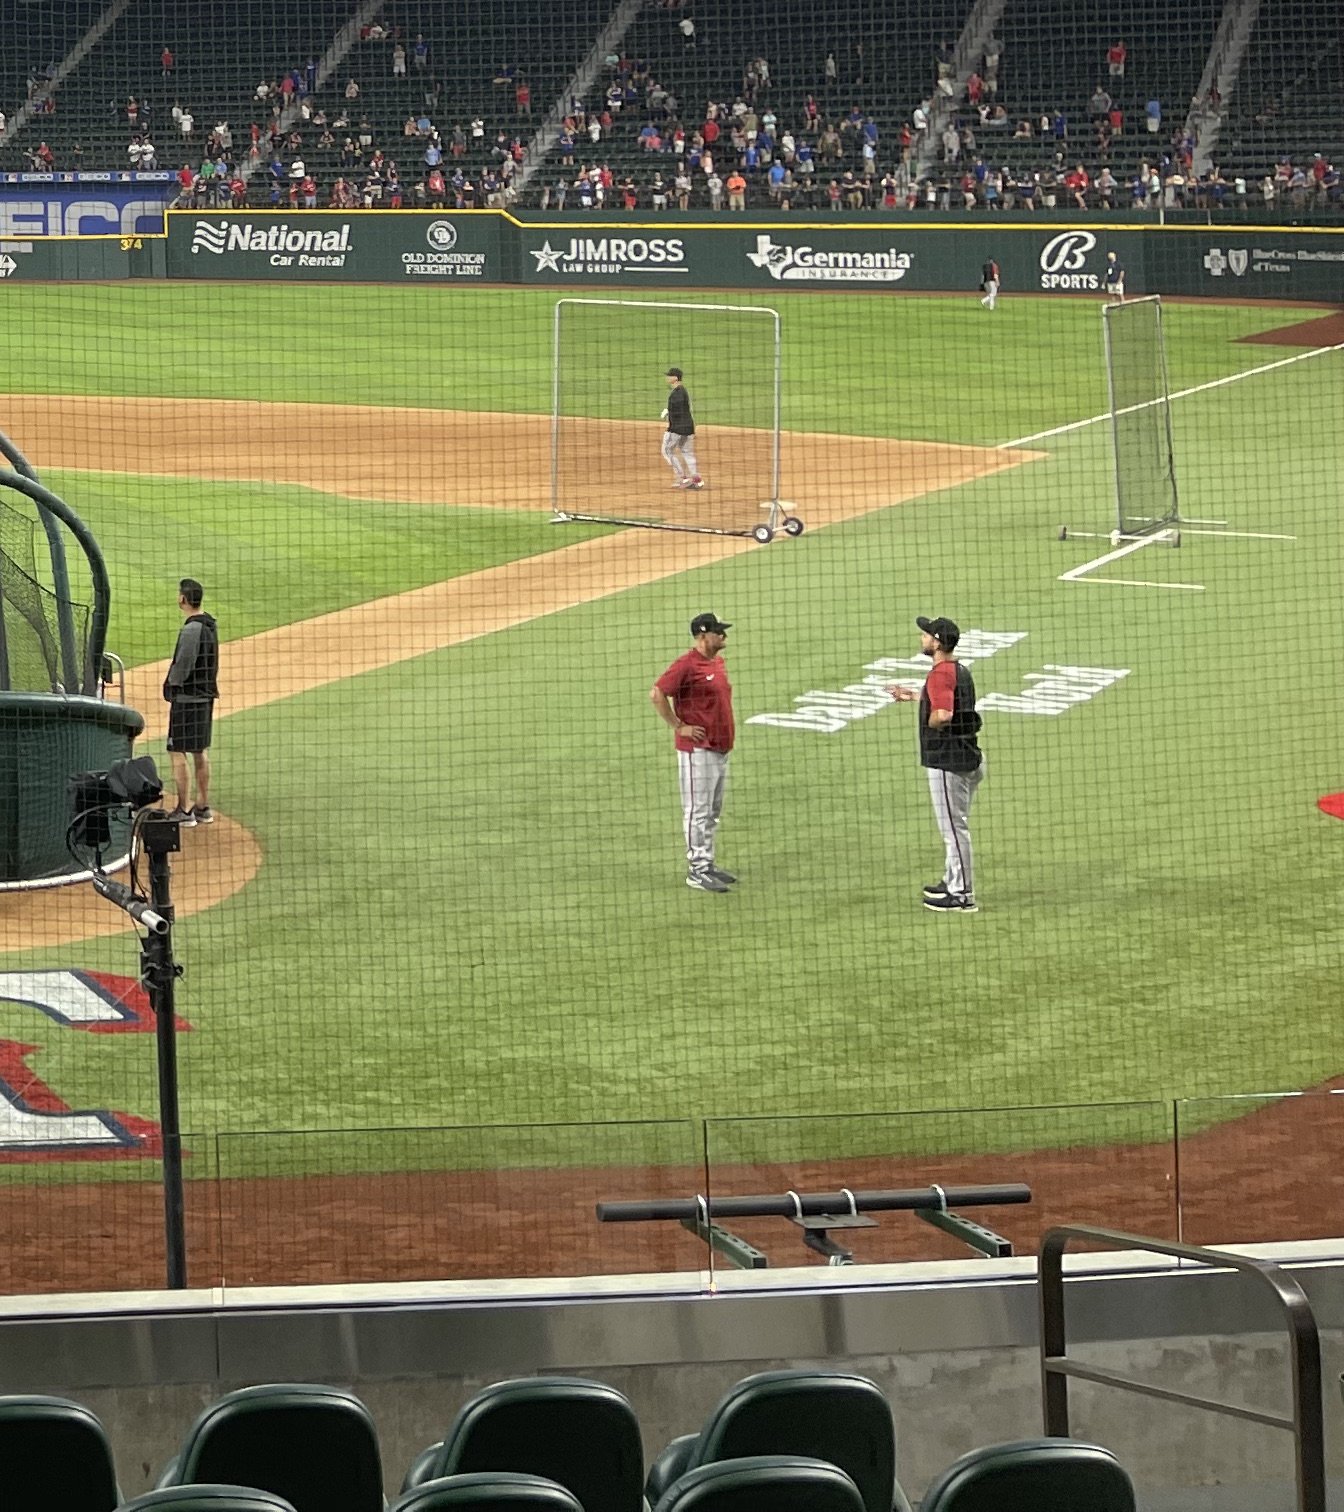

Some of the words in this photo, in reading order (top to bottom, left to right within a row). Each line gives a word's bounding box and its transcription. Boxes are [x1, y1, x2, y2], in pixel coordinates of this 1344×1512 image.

[120, 239, 143, 251] 374
[270, 254, 293, 267] Car
[298, 254, 345, 267] Rental
[401, 253, 427, 264] OLD
[428, 253, 485, 265] DOMINION
[794, 246, 910, 270] Germania
[405, 264, 454, 276] FREIGHT
[455, 265, 482, 276] LINE
[562, 263, 583, 272] LAW
[587, 263, 622, 273] GROUP
[1041, 273, 1099, 290] SPORTS
